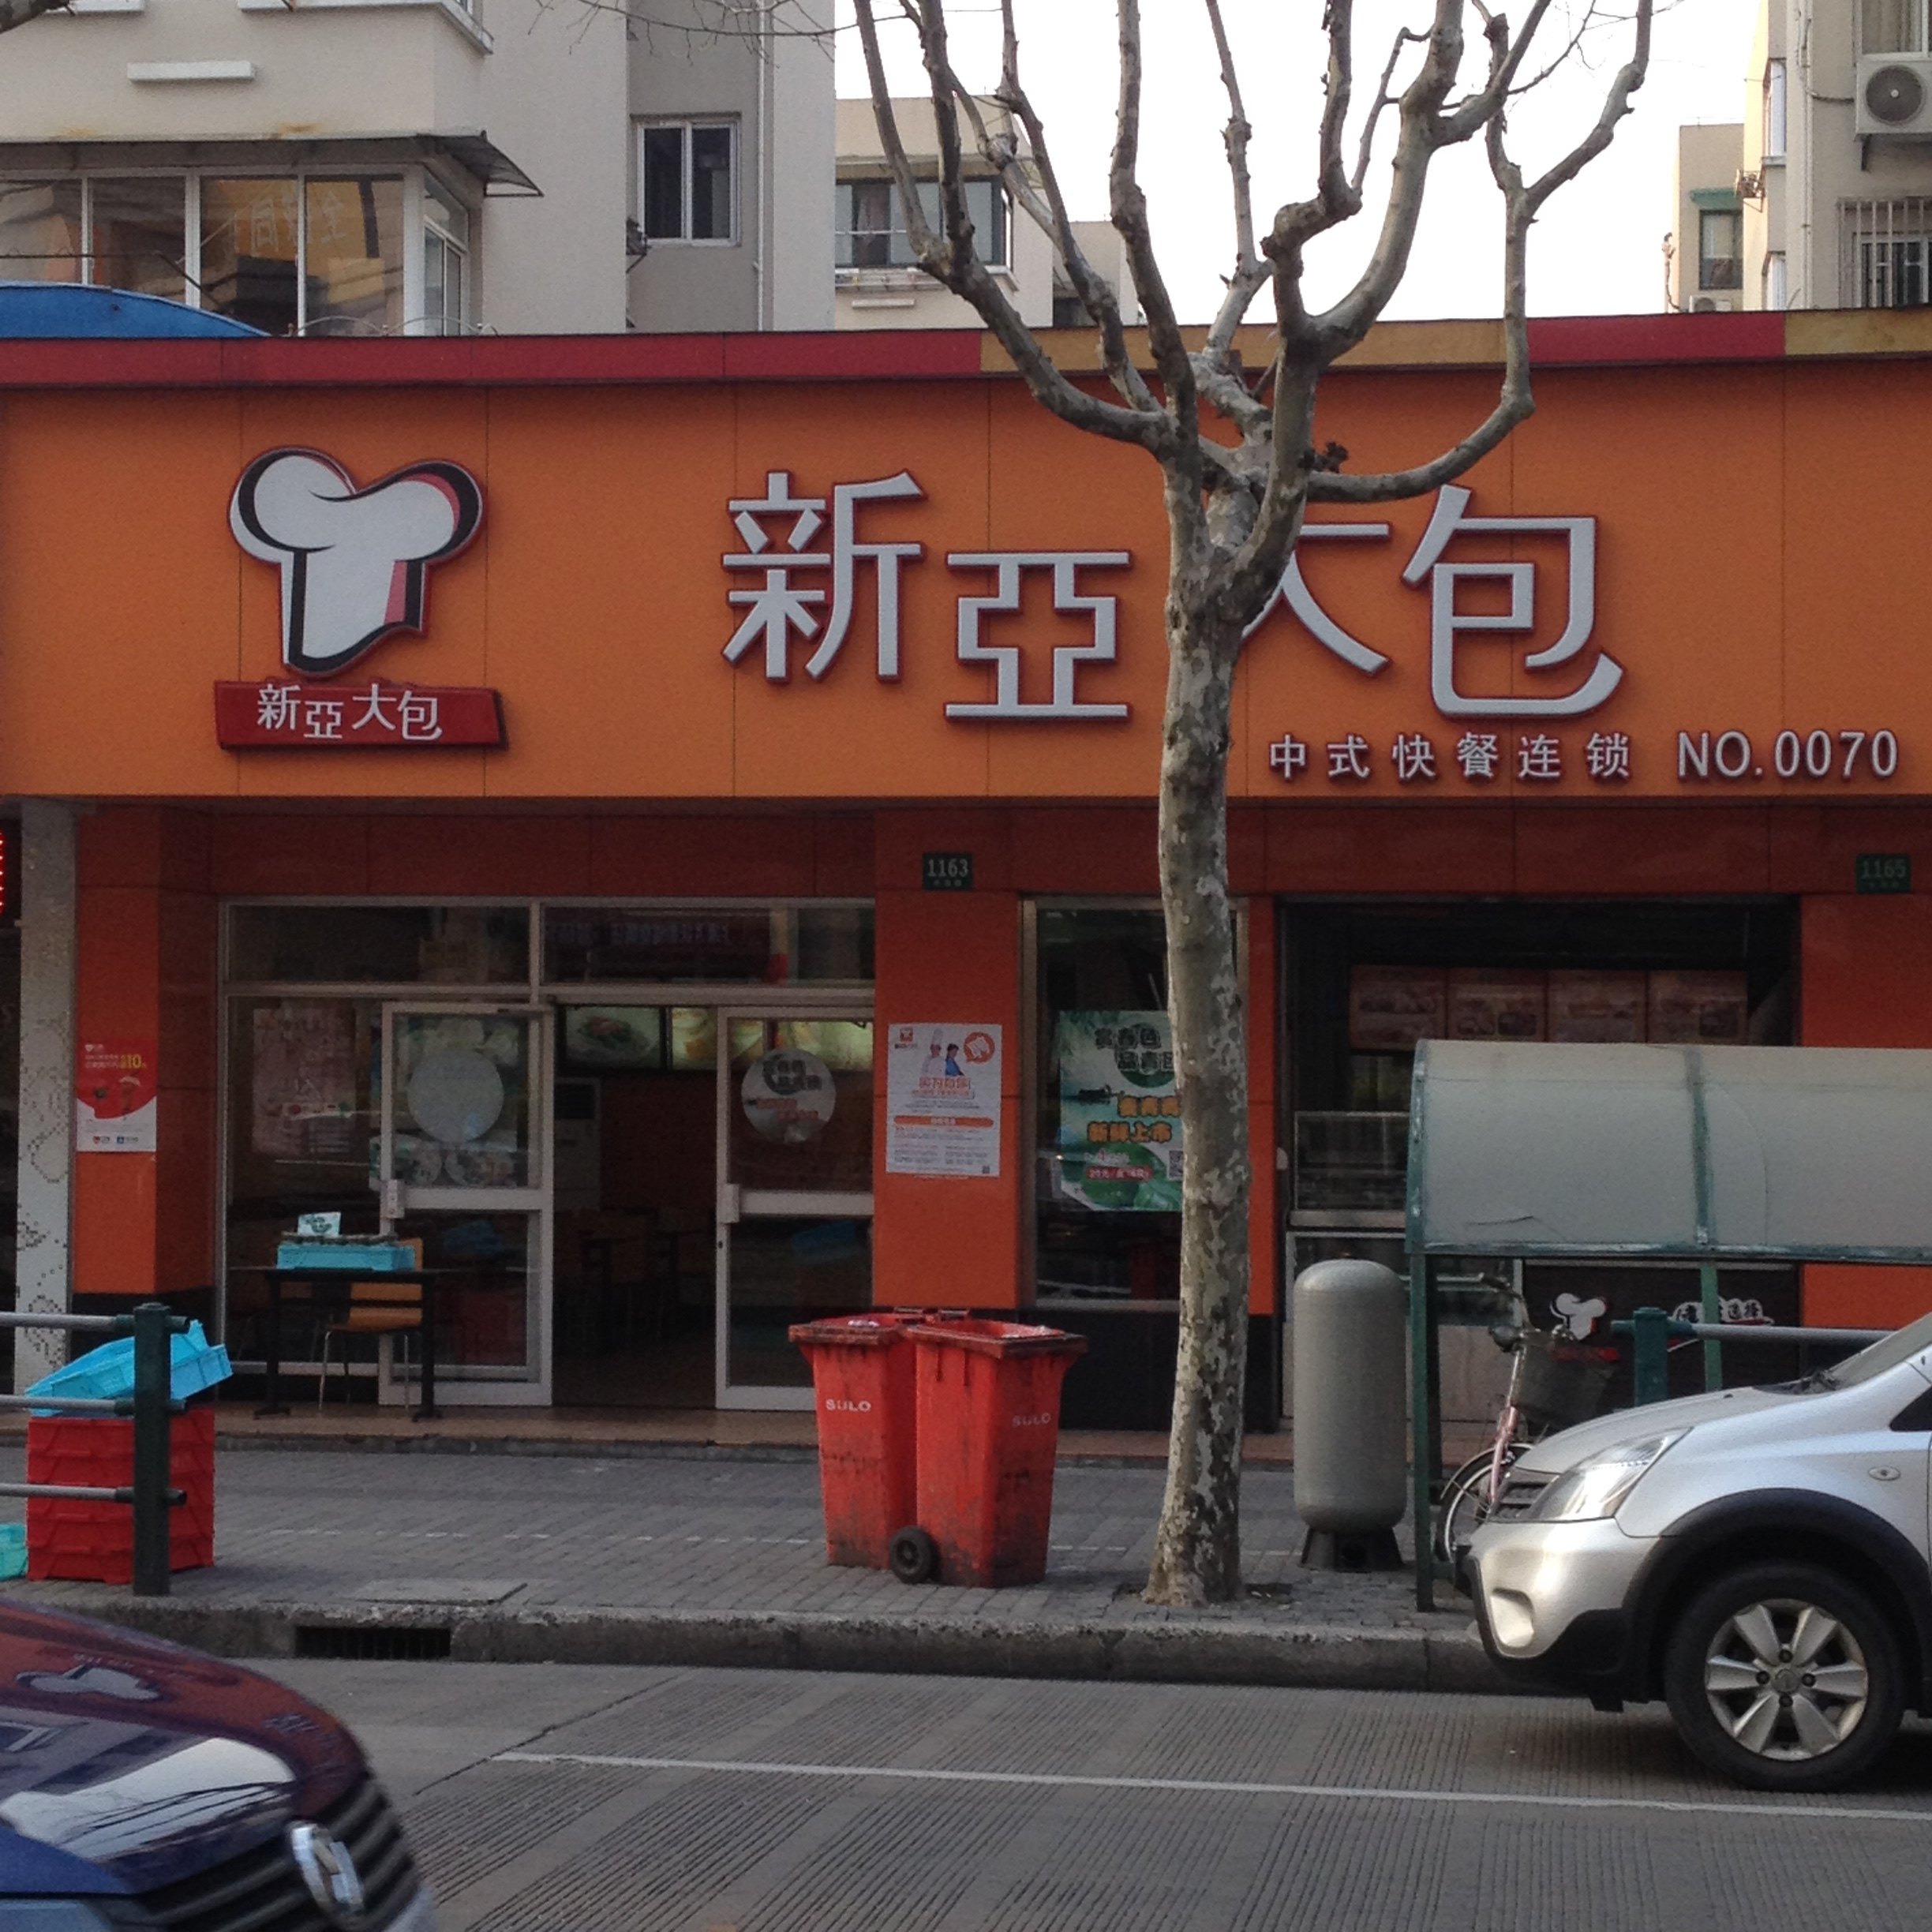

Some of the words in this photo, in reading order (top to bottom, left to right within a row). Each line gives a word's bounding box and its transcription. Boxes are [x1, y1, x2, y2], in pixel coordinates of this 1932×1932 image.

[256, 683, 444, 741] 新亞大包
[1268, 731, 1631, 780] 中式快餐连锁
[1678, 729, 1897, 777] NO.0070
[927, 858, 969, 878] 1163
[1861, 859, 1906, 878] 1165
[825, 1398, 872, 1413] SULO
